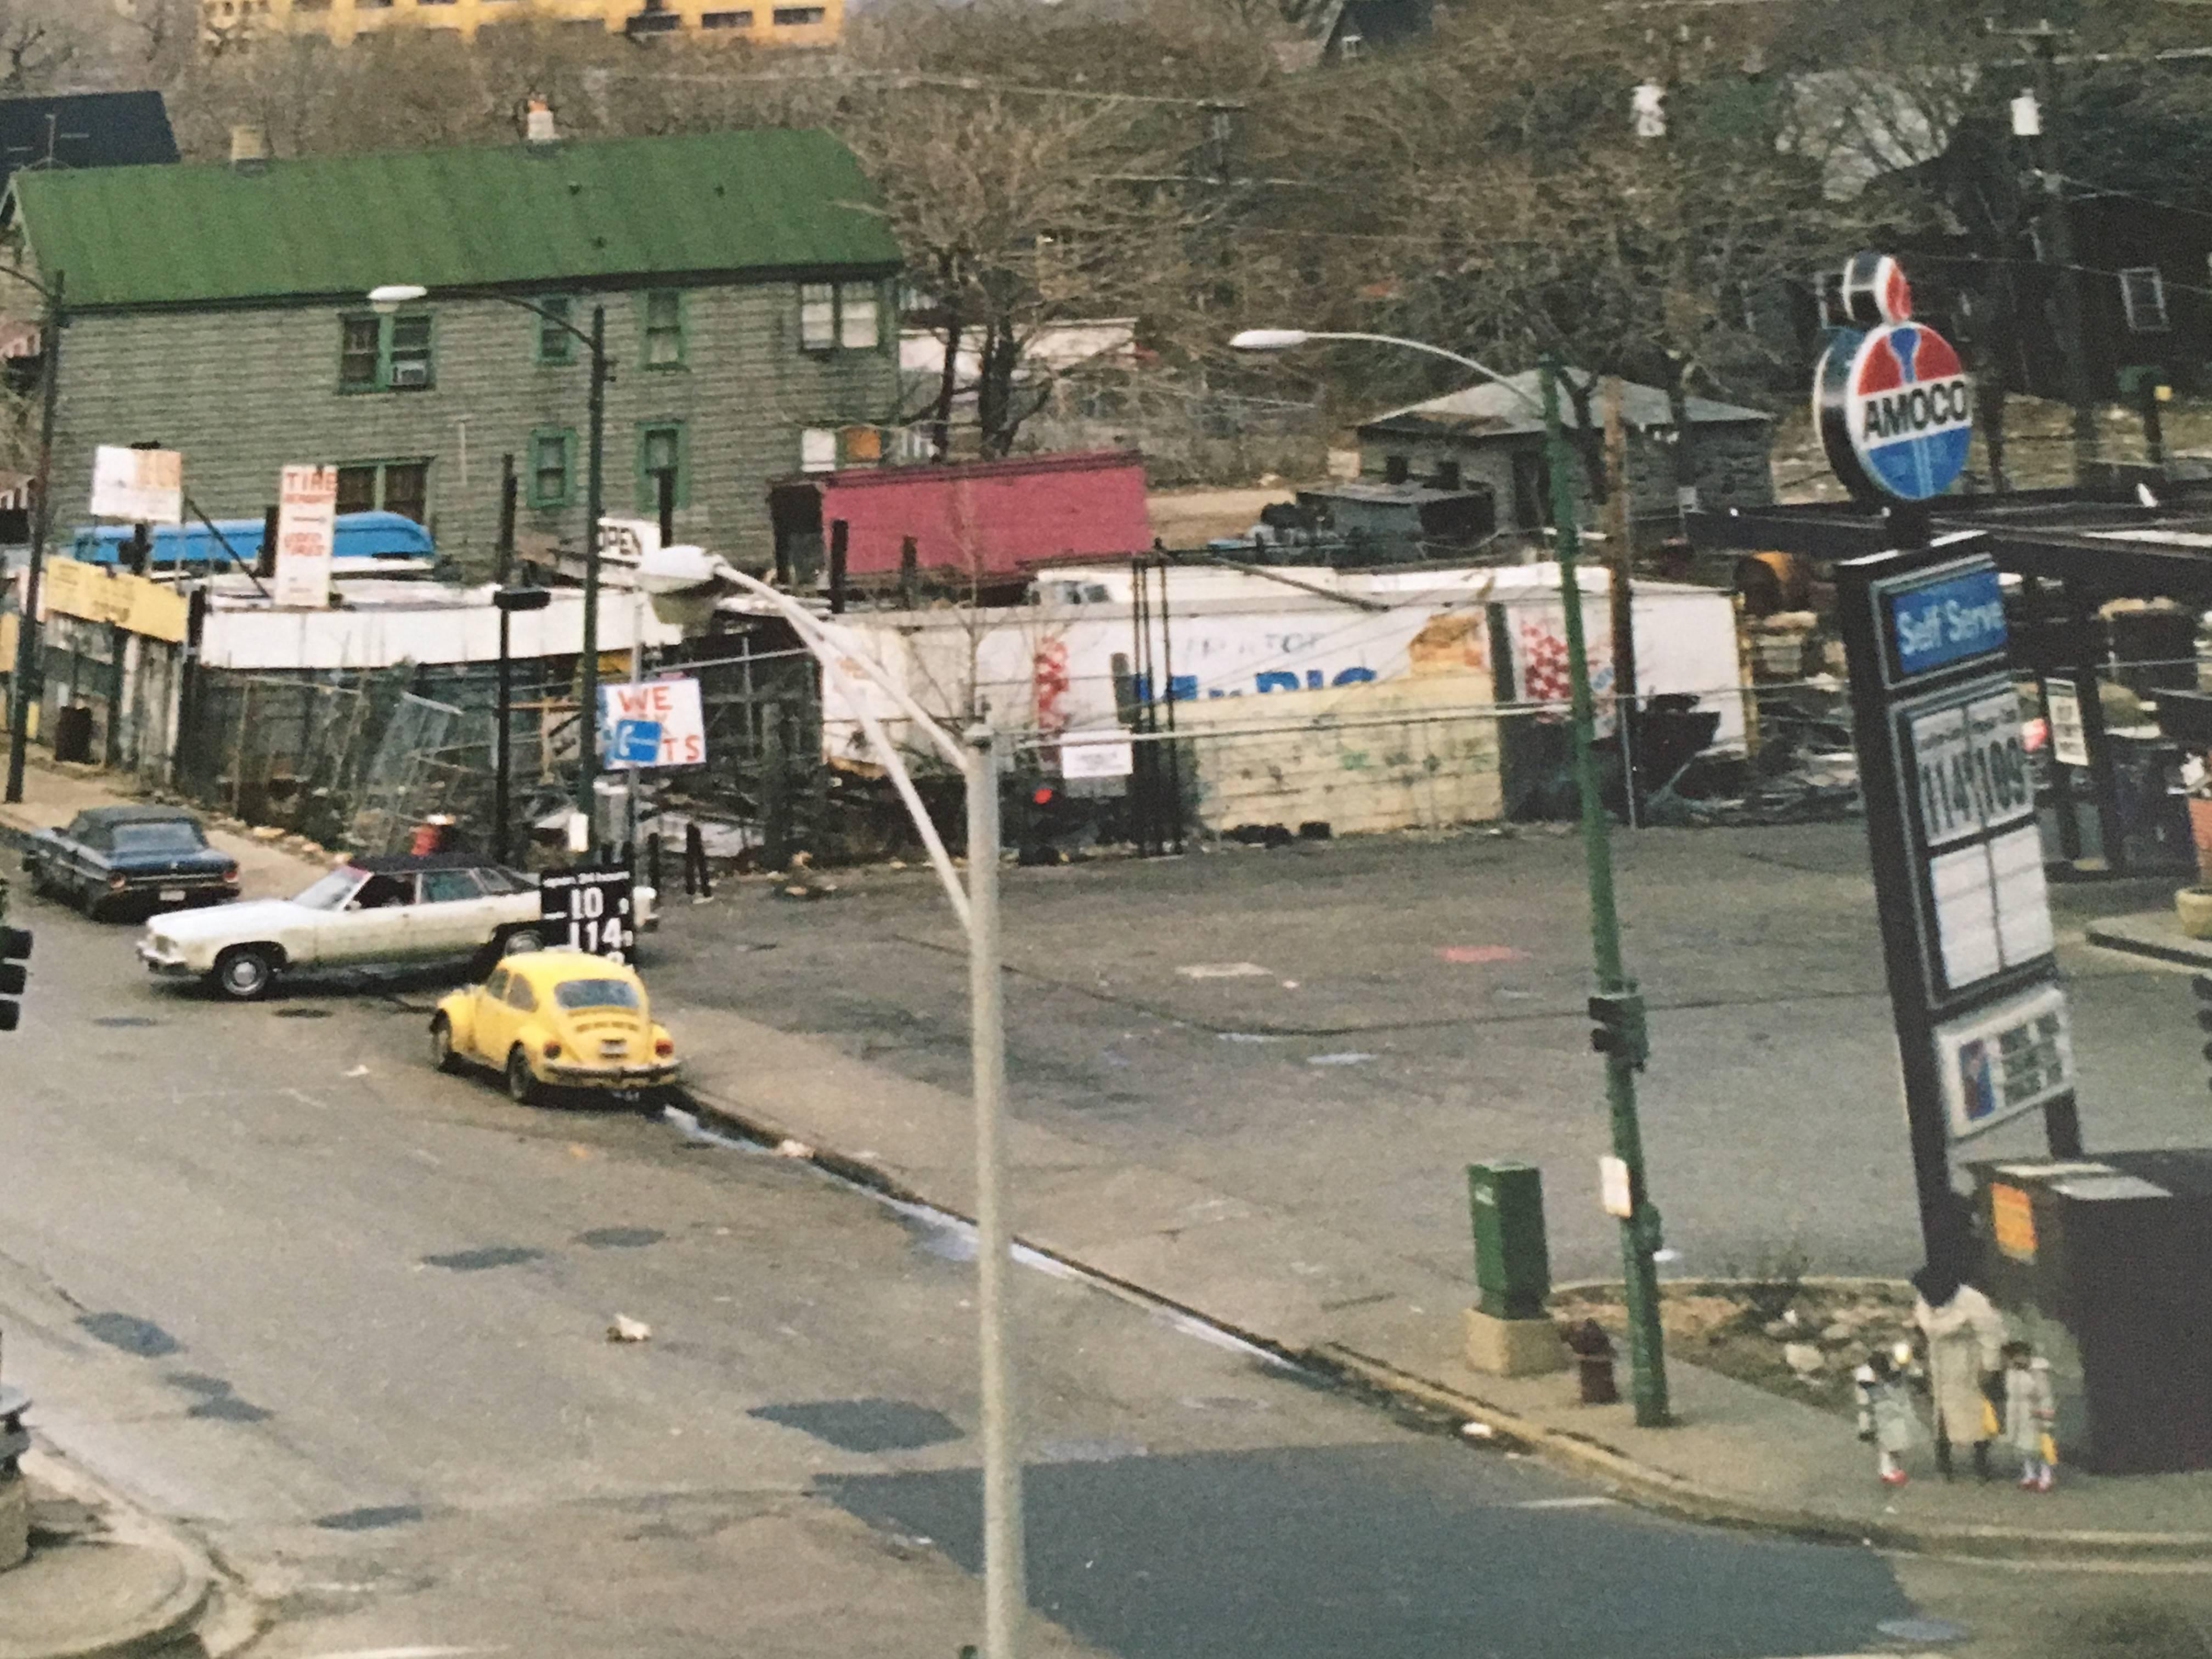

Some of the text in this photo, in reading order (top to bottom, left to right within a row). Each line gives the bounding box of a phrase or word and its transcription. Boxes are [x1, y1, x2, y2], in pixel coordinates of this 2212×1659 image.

[1863, 380, 1968, 442] AMOCO
[1898, 605, 1942, 655] Self
[618, 686, 673, 712] WE
